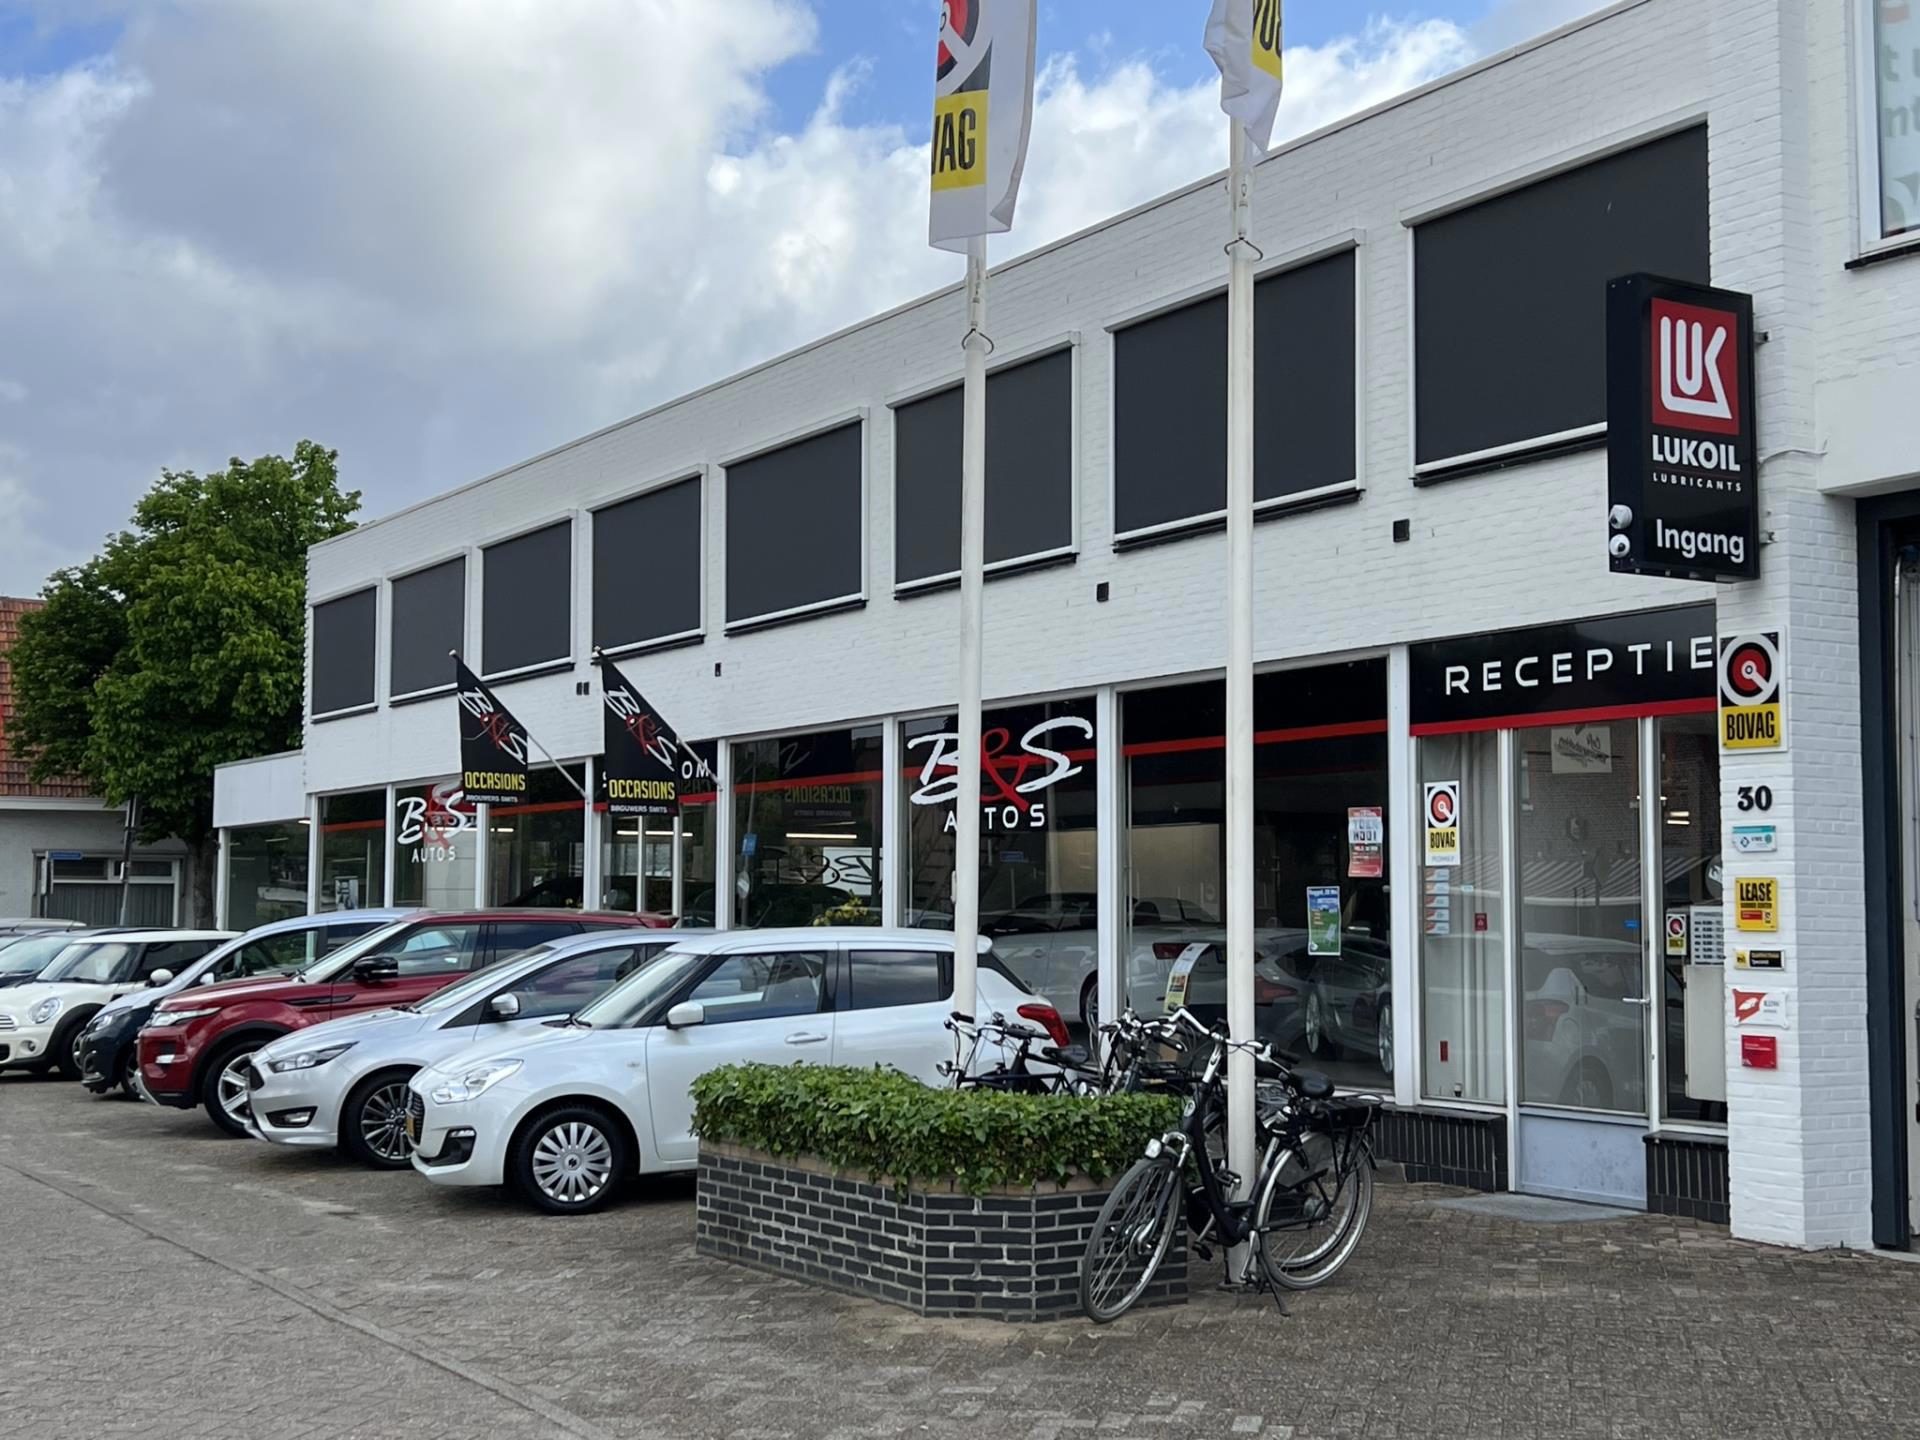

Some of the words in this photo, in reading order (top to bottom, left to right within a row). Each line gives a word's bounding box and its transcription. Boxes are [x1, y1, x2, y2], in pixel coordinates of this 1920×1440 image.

[1652, 434, 1741, 472] LUKOIL
[1652, 472, 1742, 492] LUBRICANTS
[1656, 519, 1745, 564] Ingang
[1445, 635, 1713, 695] RECEPTIE
[1726, 710, 1775, 740] BOVAG
[464, 771, 526, 791] OCCASIONS
[608, 779, 676, 800] OCCASIONS
[1737, 784, 1773, 811] 30
[943, 803, 1046, 833] ATOS
[1430, 831, 1456, 849] BOVAG
[411, 845, 456, 863] AUTOS
[1740, 883, 1772, 901] LEASE
